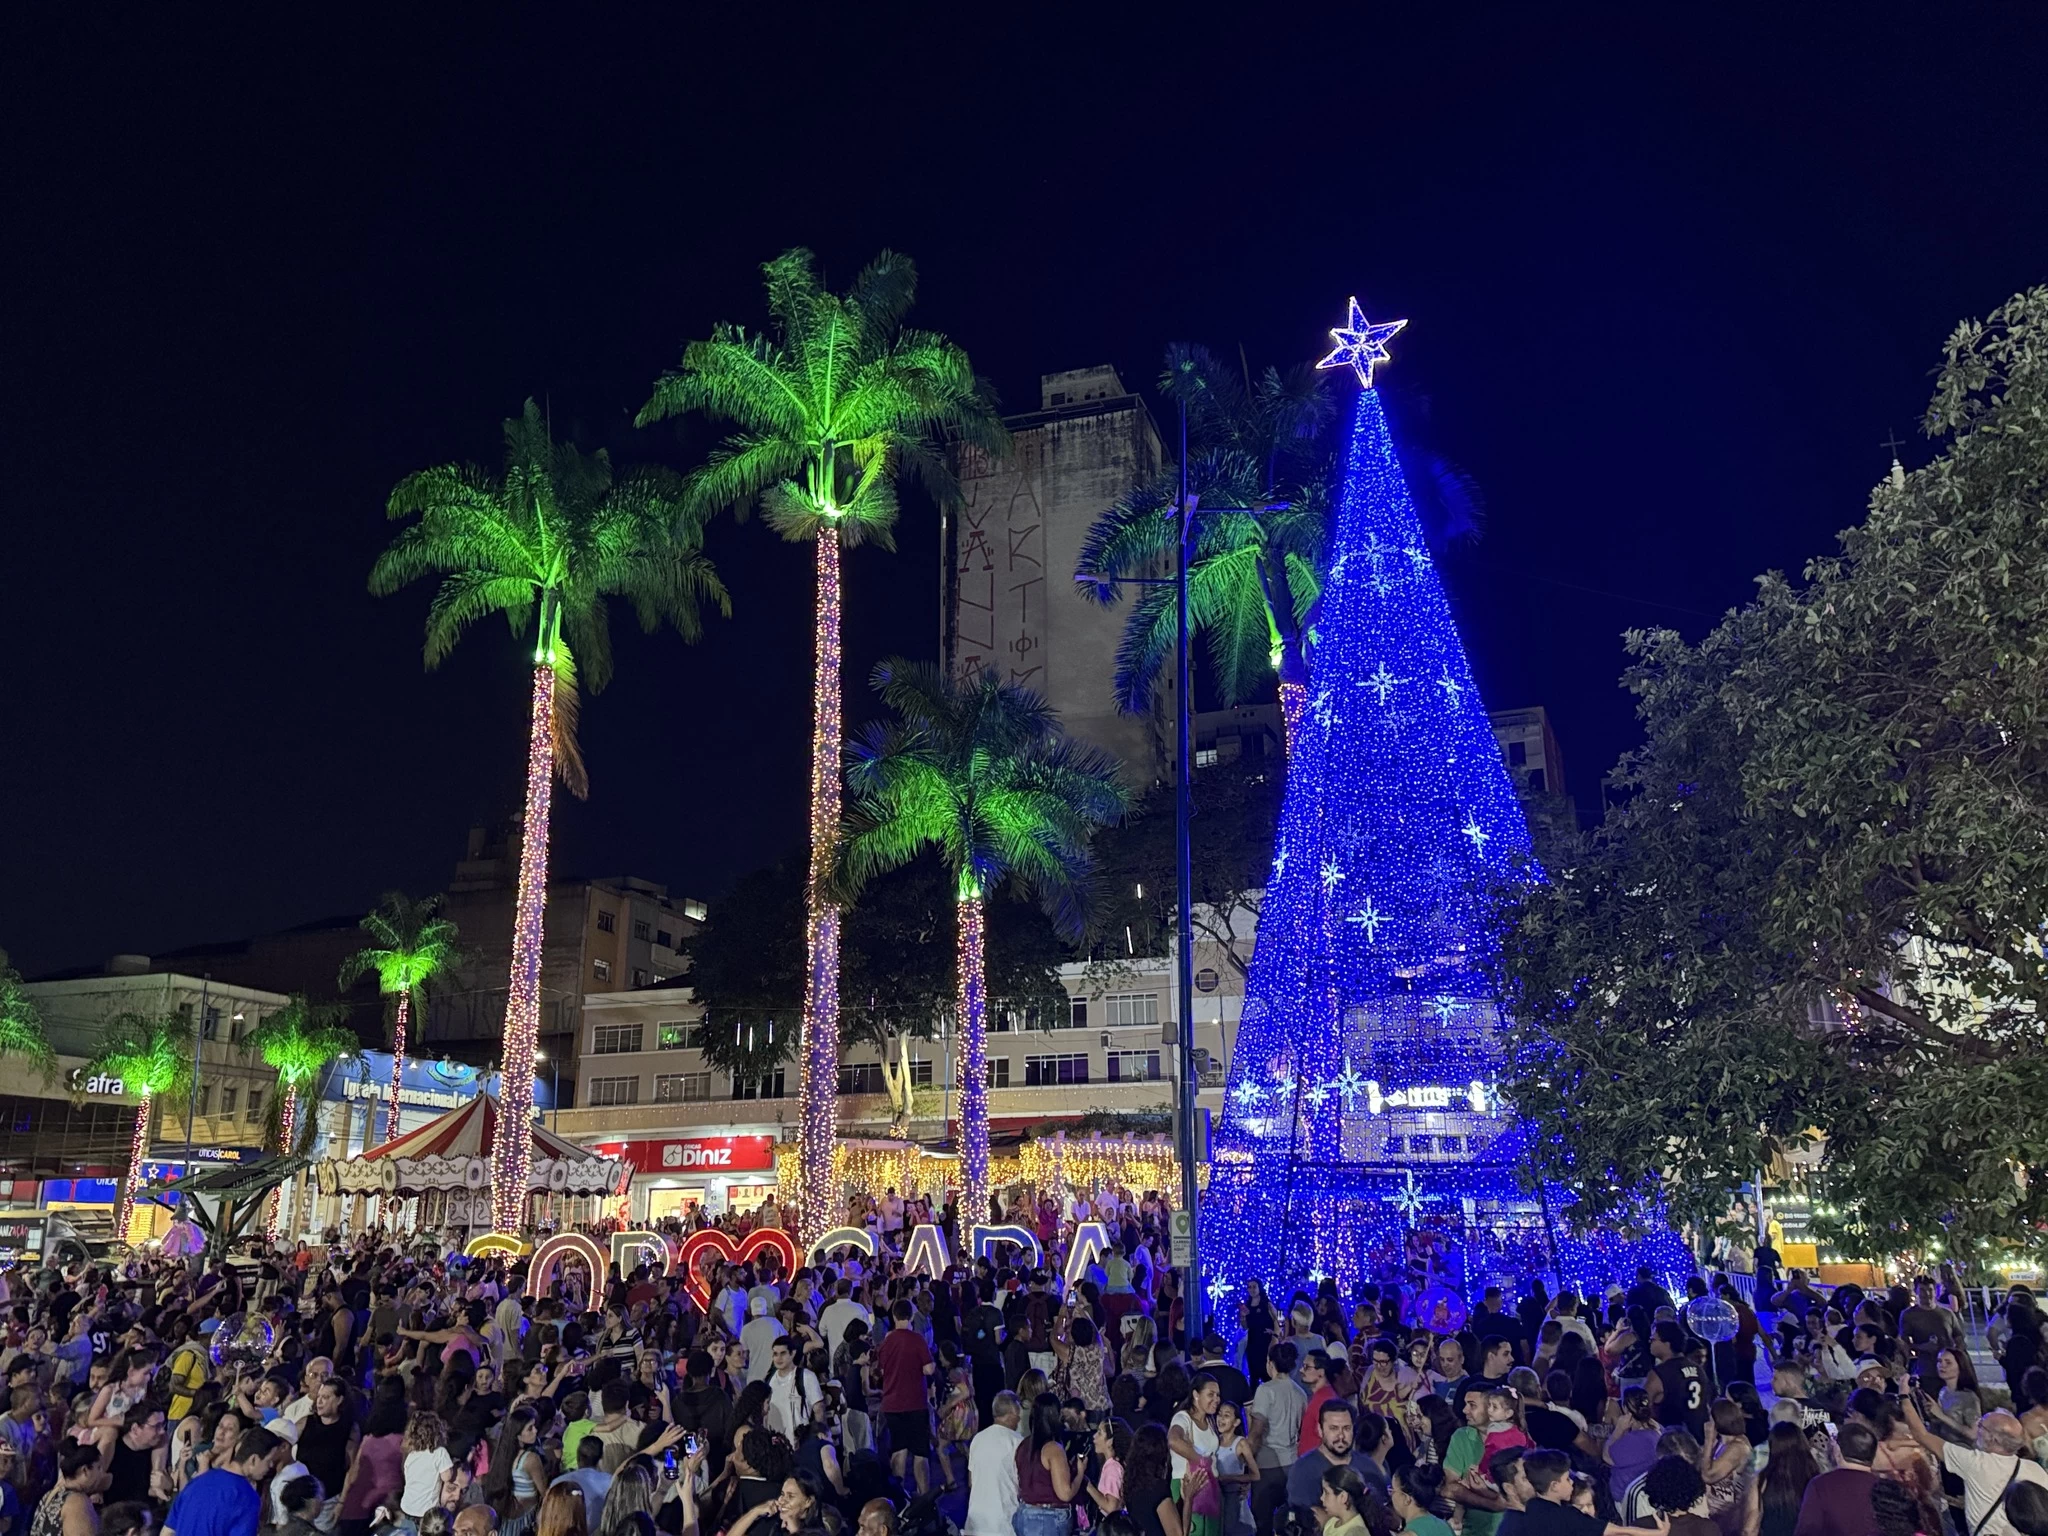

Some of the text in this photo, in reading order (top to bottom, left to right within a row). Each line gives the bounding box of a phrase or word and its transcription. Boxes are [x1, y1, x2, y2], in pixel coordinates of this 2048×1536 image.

[382, 1083, 458, 1109] Inernacional
[219, 1149, 241, 1160] CAROL
[682, 1149, 731, 1166] DINIZ
[1687, 1381, 1701, 1409] 3
